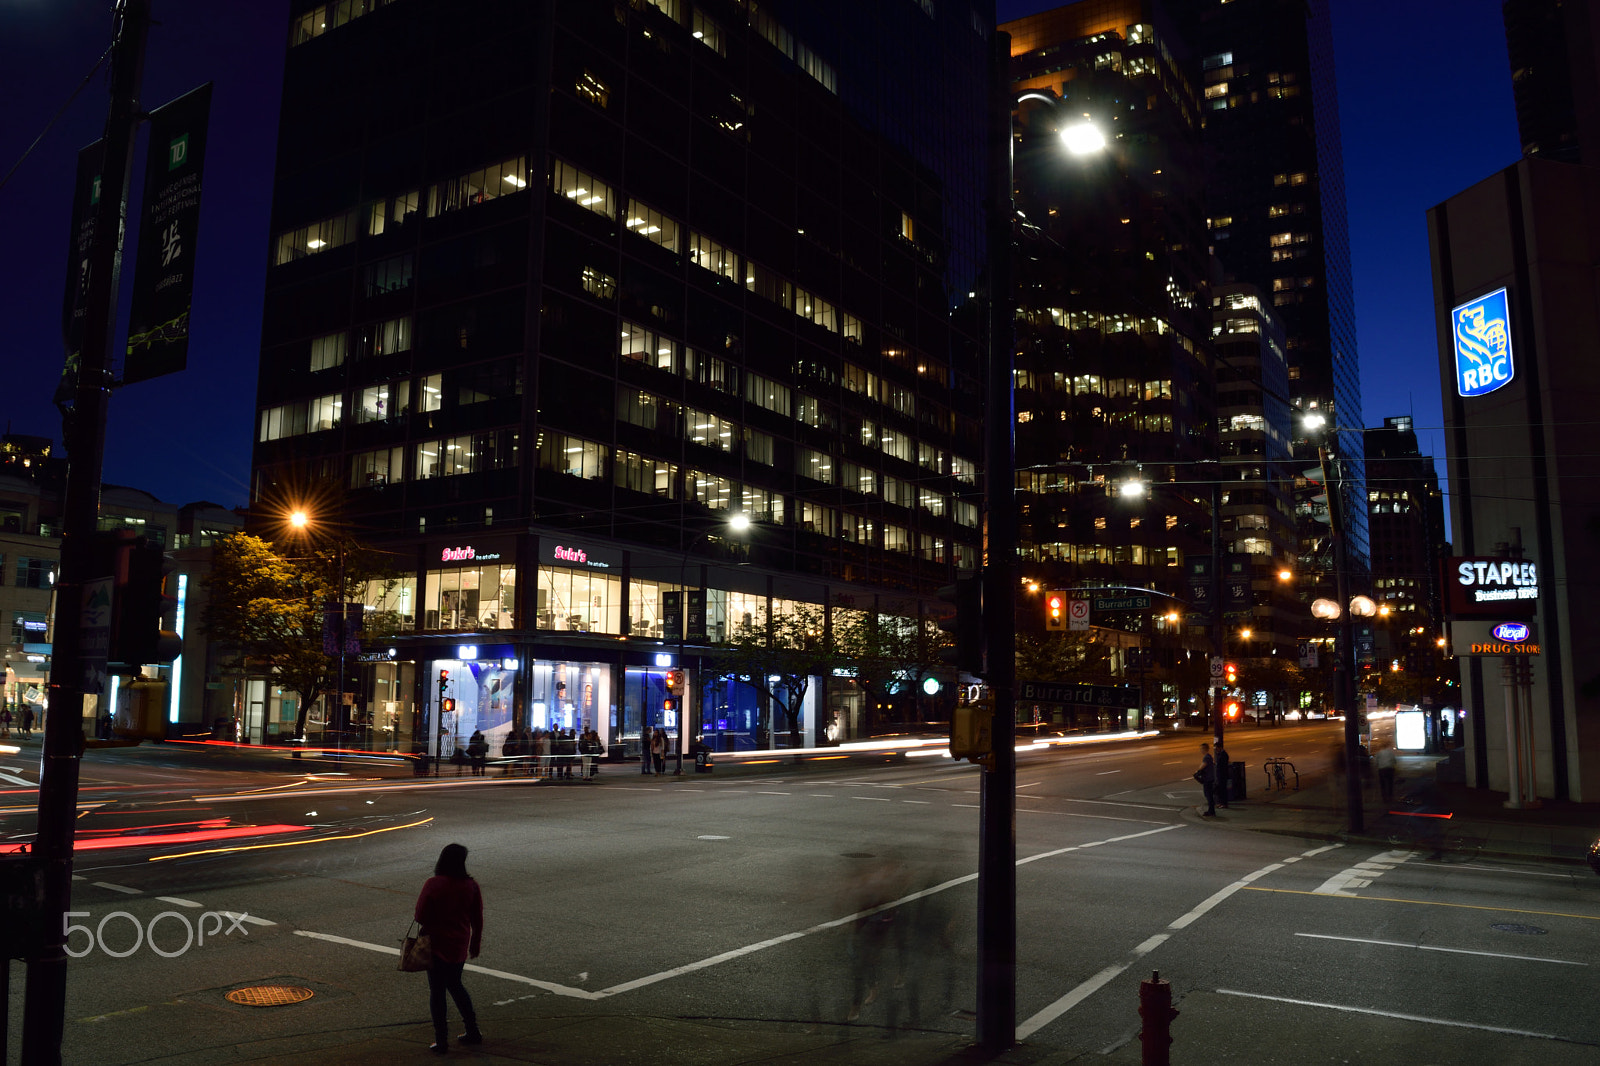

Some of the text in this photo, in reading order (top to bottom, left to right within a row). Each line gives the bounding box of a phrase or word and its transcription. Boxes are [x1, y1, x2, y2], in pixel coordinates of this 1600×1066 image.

[170, 141, 186, 164] TD
[1463, 358, 1508, 392] RBC
[442, 545, 475, 562] Suki's
[554, 545, 587, 563] Suki's
[1458, 561, 1537, 585] STAPLES
[1475, 587, 1517, 601] Business
[1098, 598, 1147, 609] Burrard St
[1499, 625, 1526, 640] Rexall
[1471, 643, 1511, 653] DRUG
[1212, 663, 1222, 672] 99
[1025, 684, 1093, 702] Burrard
